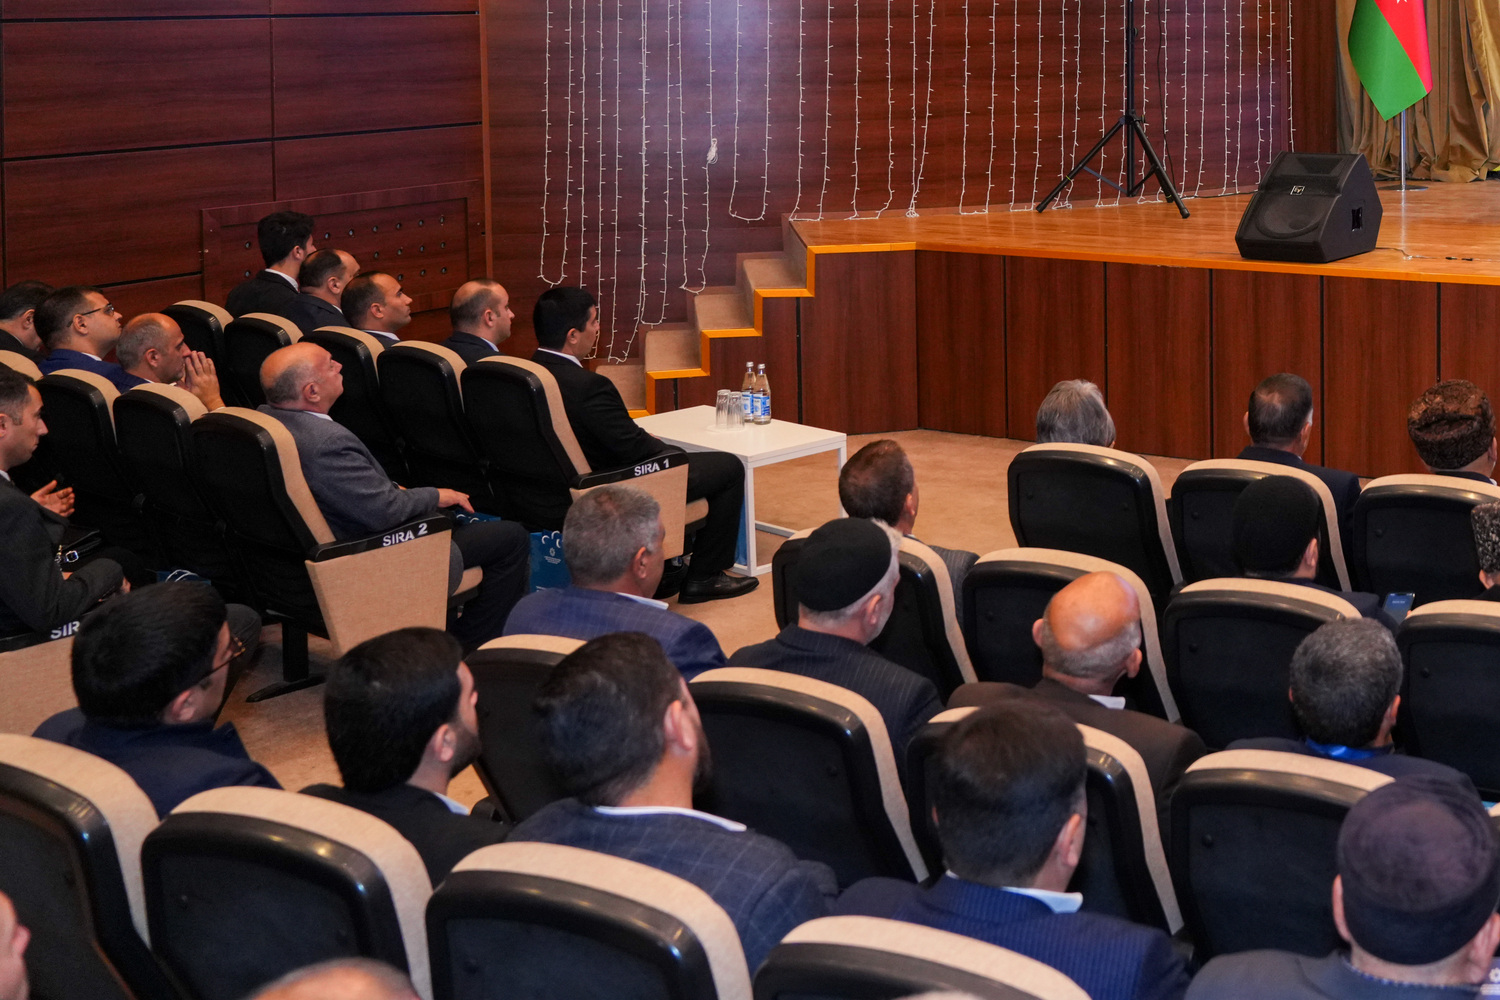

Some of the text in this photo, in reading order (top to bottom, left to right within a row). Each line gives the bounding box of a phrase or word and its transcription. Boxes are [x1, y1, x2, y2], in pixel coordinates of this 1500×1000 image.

[634, 458, 670, 476] SIRA 1
[382, 522, 428, 547] SIRA 2
[50, 620, 81, 639] SIR
